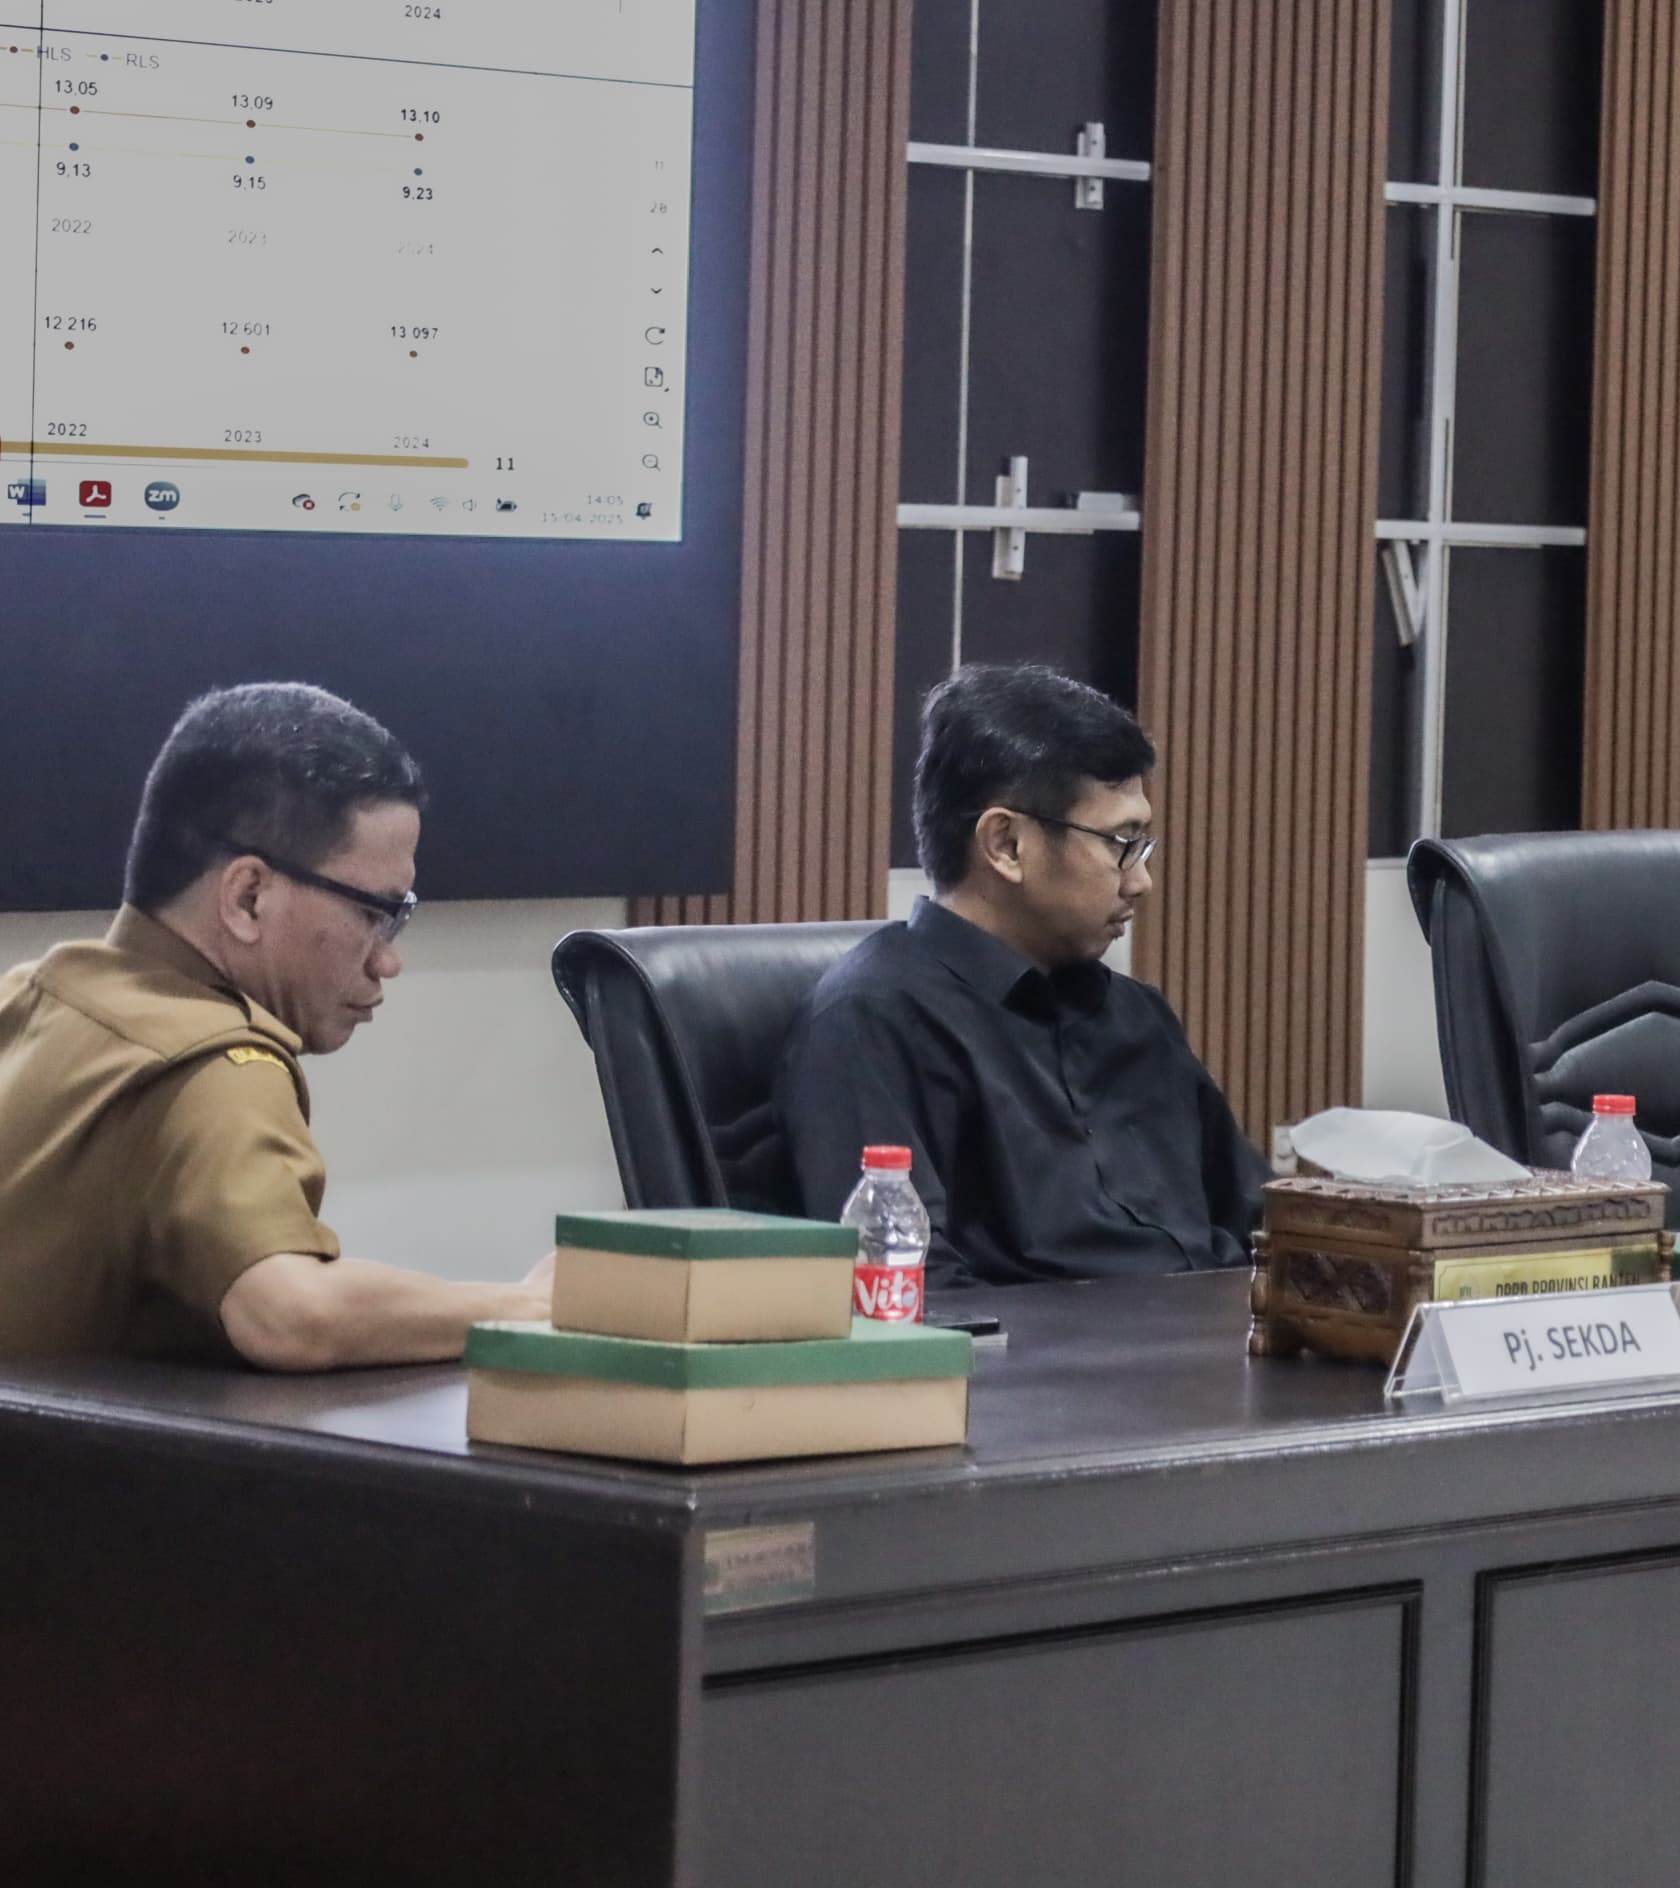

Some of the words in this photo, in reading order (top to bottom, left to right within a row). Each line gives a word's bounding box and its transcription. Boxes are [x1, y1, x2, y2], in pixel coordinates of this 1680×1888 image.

[405, 5, 441, 19] 2024
[37, 46, 72, 61] HLS
[126, 53, 160, 69] RLS
[55, 80, 98, 96] 13.05
[232, 95, 274, 110] 13.09
[401, 109, 441, 124] 13.10
[56, 162, 91, 178] 9.13
[233, 175, 266, 190] 9.15
[402, 186, 433, 201] 9.23
[51, 218, 92, 234] 2022
[47, 422, 88, 437] 2022
[224, 429, 262, 443] 2023
[495, 457, 515, 471] 11
[1503, 1328, 1544, 1371] Pj.
[1547, 1321, 1642, 1361] SEKDA
